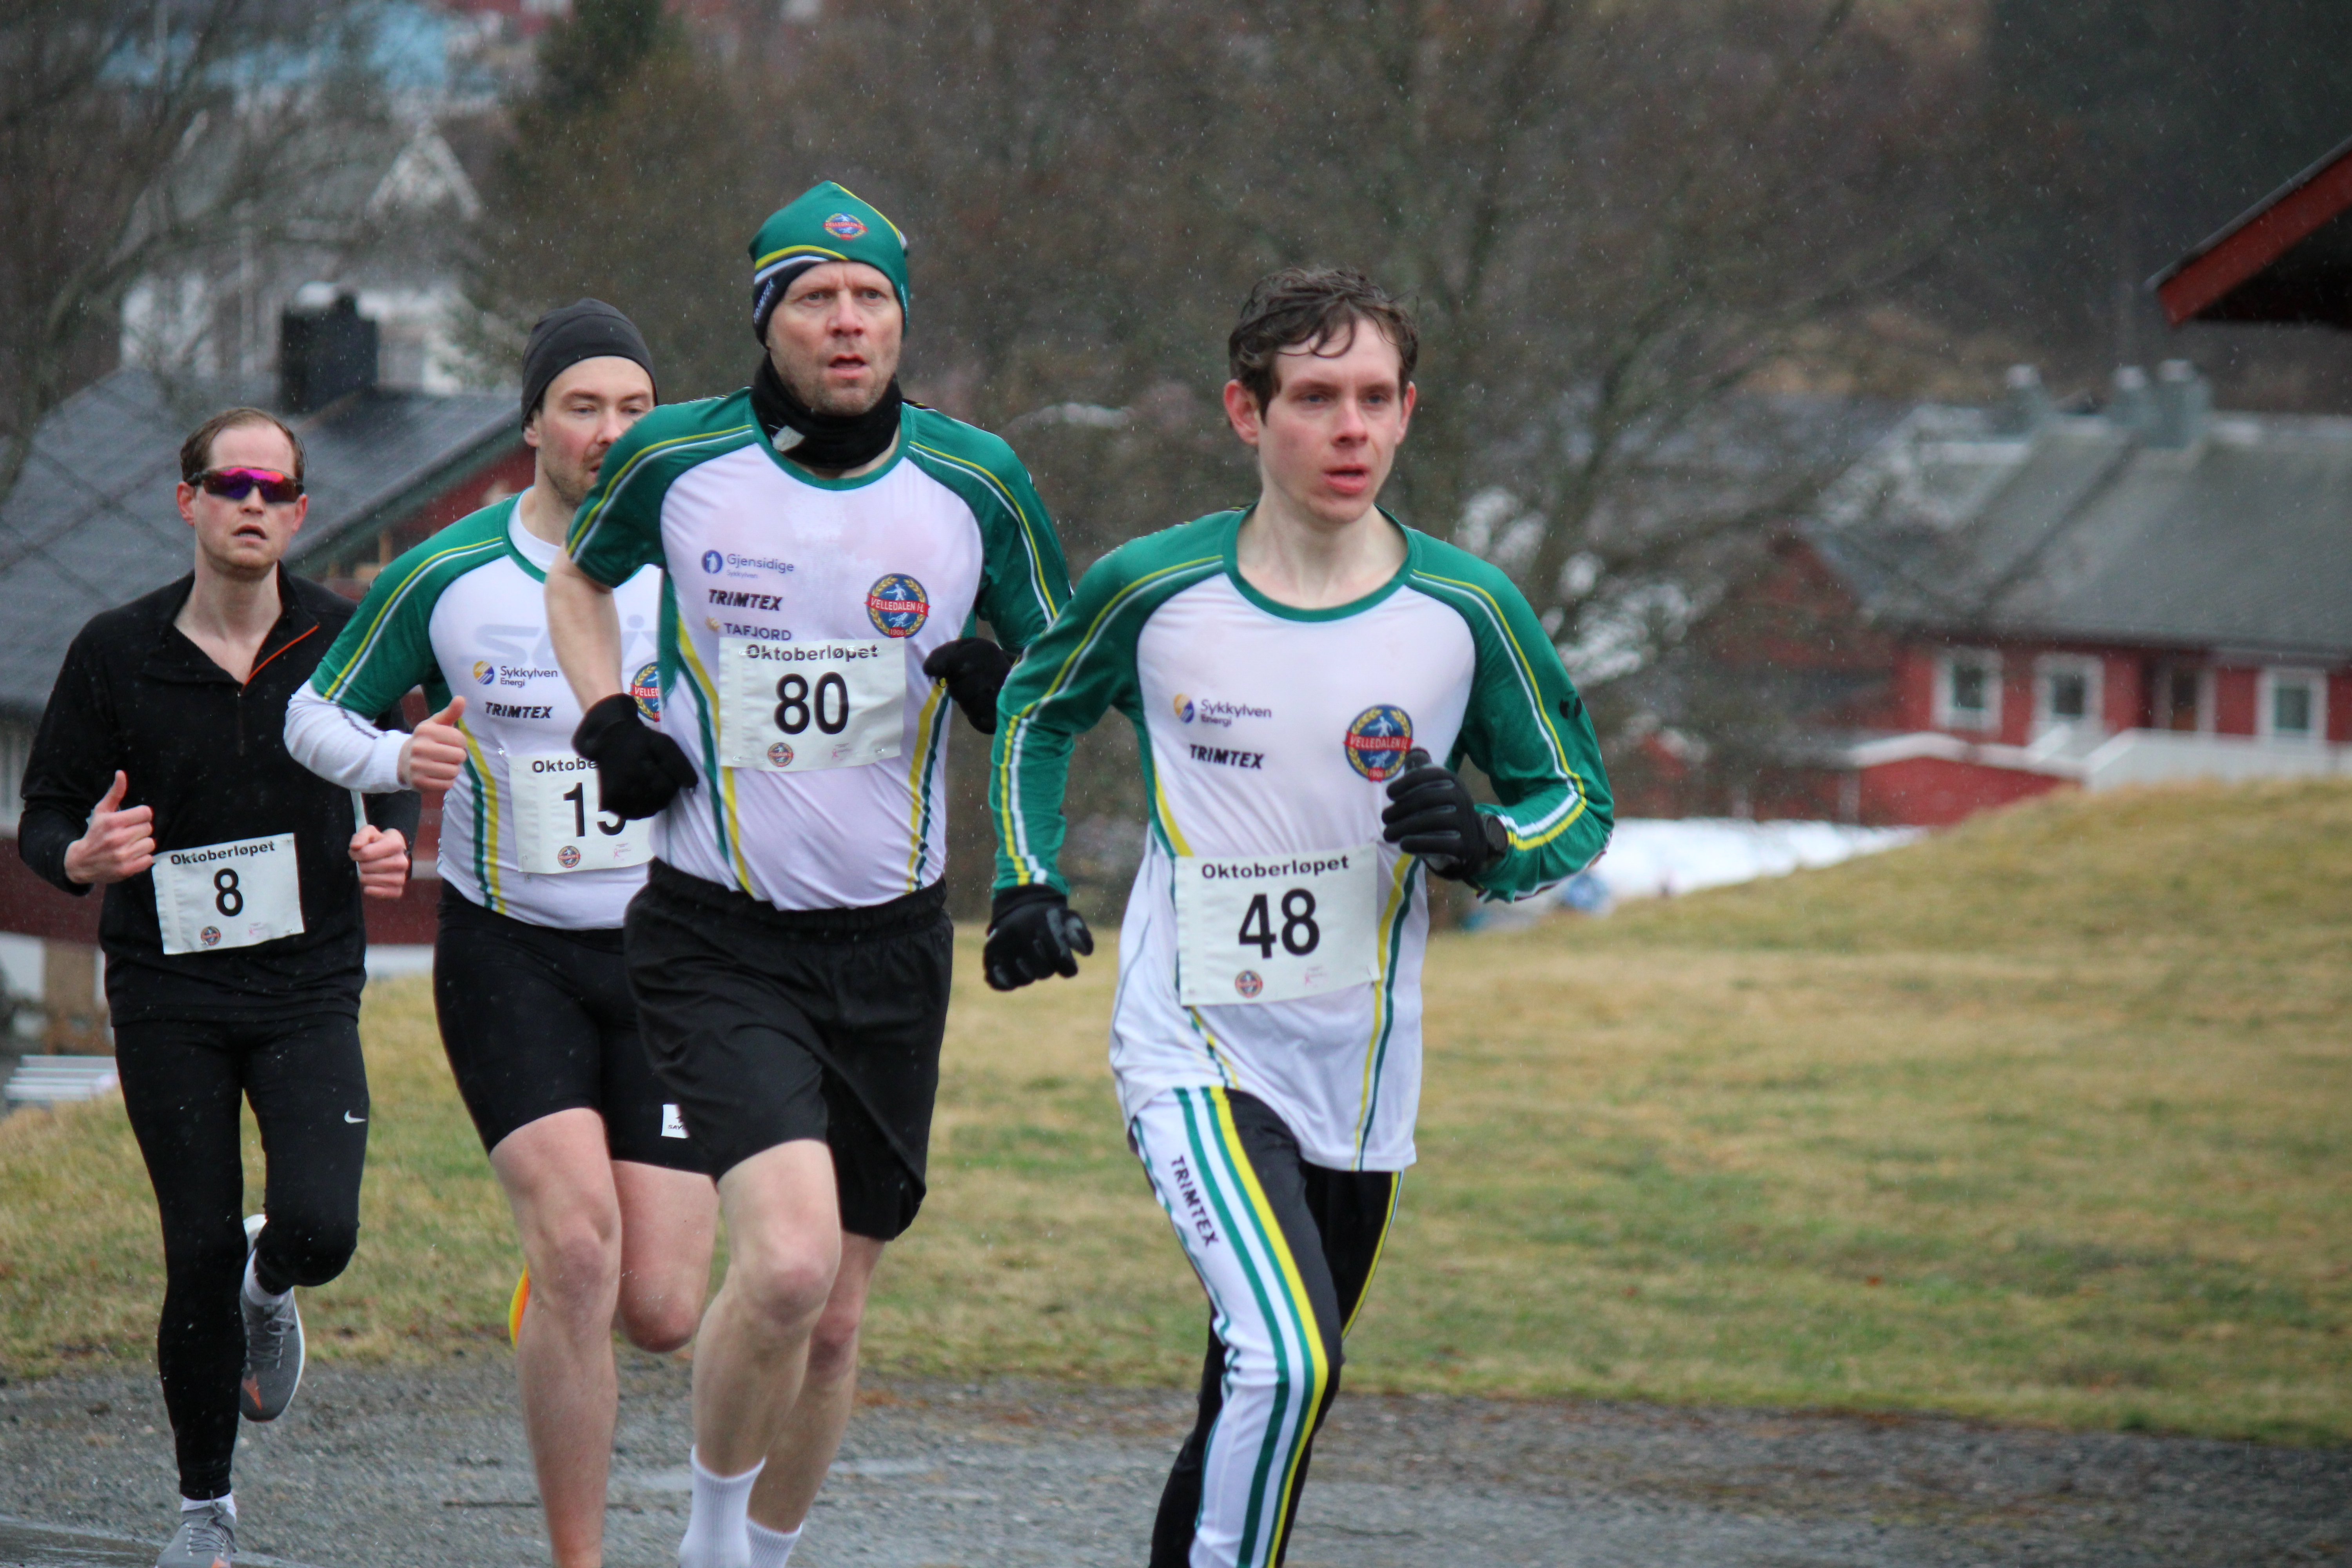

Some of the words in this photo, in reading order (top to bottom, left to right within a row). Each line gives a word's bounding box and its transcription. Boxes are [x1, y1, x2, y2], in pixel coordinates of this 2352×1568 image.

[727, 553, 794, 573] Gjensidige
[726, 569, 758, 579] Sykkylven
[708, 588, 783, 611] TRIMTEX
[871, 597, 915, 611] VELLEDALEN
[724, 622, 792, 641] TAFJORD
[746, 644, 879, 662] Oktoberløpet
[500, 665, 558, 679] Sykkylven
[500, 677, 525, 688] Energi
[485, 701, 553, 719] TRIMTEX
[773, 671, 849, 735] 80
[1200, 699, 1272, 719] Sykkylven
[1200, 714, 1232, 728] Energi
[1350, 735, 1401, 749] VELLEDALEN
[1189, 744, 1265, 769] TRIMTEX
[170, 840, 275, 866] Oktoberløpet
[1201, 854, 1349, 879] Oktoberløpet
[214, 867, 243, 917] 8
[1238, 887, 1320, 959] 48
[1171, 1154, 1219, 1248] TRIMTEX
